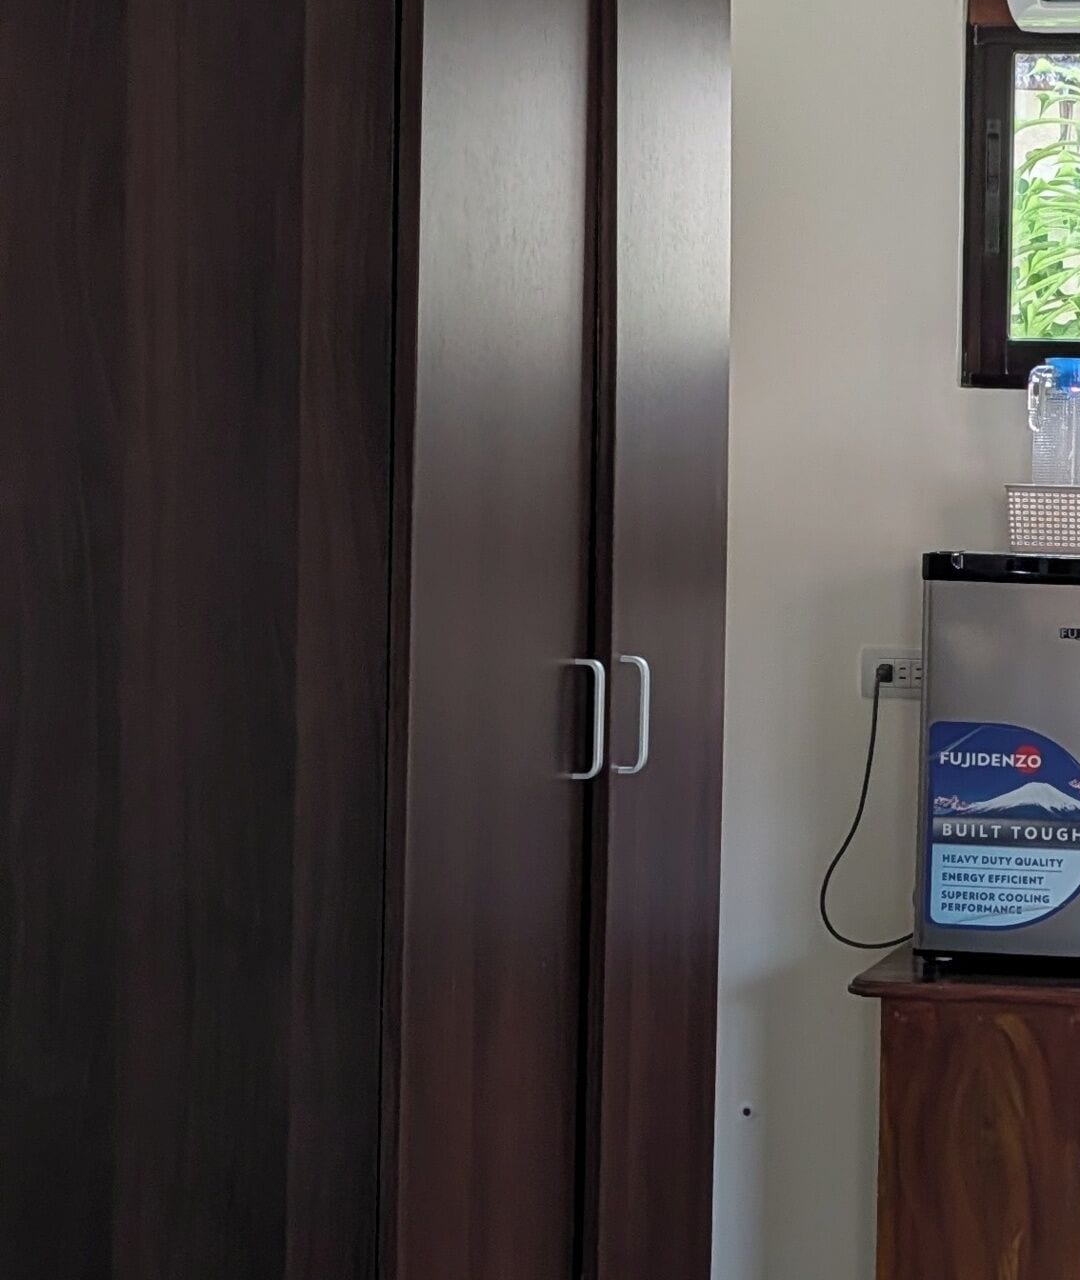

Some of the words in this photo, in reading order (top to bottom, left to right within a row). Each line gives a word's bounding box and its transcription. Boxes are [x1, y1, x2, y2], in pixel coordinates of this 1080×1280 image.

[939, 751, 1042, 769] FUJIDENZO
[942, 823, 1002, 839] BUILT
[942, 854, 979, 865] HEAVY
[981, 856, 1013, 866] DUTY
[1014, 857, 1064, 868] QUALITY
[941, 872, 985, 883] ENERGY
[988, 873, 1045, 885] EFFICIENT
[941, 890, 995, 902] SUPERIOR
[998, 892, 1050, 904] COOLING
[941, 903, 1023, 915] PERFORMANCE
